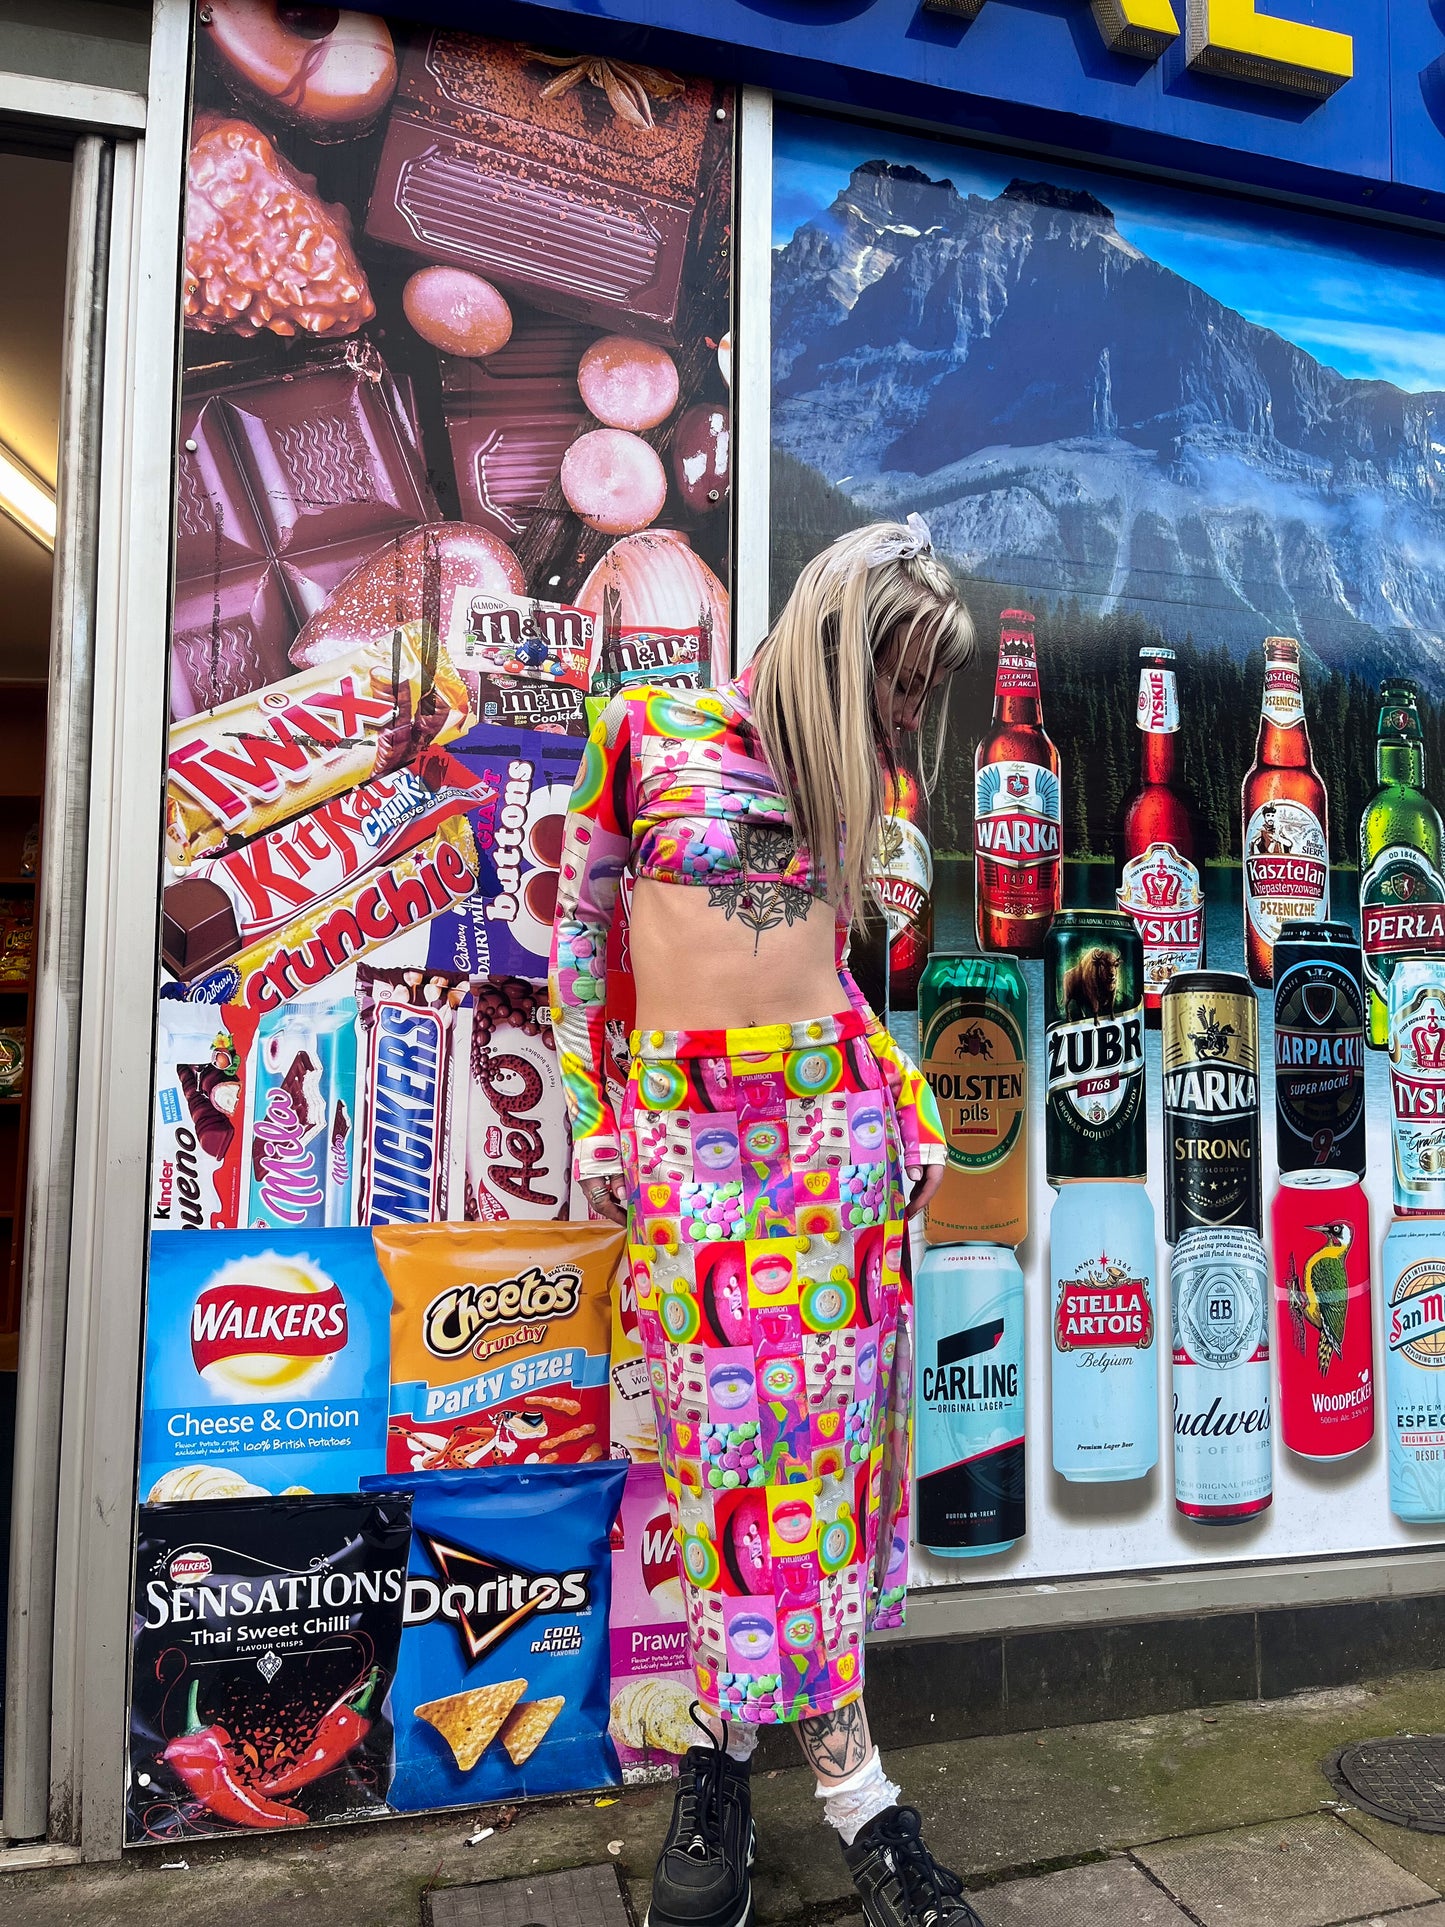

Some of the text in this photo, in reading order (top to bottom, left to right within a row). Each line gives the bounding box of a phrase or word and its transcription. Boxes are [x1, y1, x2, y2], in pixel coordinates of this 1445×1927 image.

[472, 601, 504, 610] ALMOND
[1150, 672, 1164, 729] TYSKIE
[530, 710, 583, 724] Cookies
[392, 806, 424, 827] have
[427, 799, 437, 809] a
[478, 769, 501, 850] GIAT
[485, 759, 534, 923] buttons
[976, 820, 1059, 853] WARKA
[1302, 846, 1324, 858] SIERPC
[1388, 850, 1417, 861] OD 1846
[1002, 874, 1033, 884] 1478
[1248, 860, 1325, 887] Kasztelan
[1253, 882, 1322, 897] Niepasteryzowane
[1260, 901, 1316, 917] PSZENICZNE
[1134, 916, 1199, 944] YSKIE
[1367, 914, 1445, 942] PERŁA
[453, 923, 472, 972] Cadbury
[475, 925, 491, 975] DAIRY
[523, 1048, 557, 1088] feel the bubbles
[742, 1073, 772, 1082] Intuition
[926, 1072, 1023, 1101] HOLSTEN
[1086, 1079, 1110, 1092] 1768
[1164, 1070, 1257, 1112] WARKA
[1290, 1074, 1350, 1096] SUPER MOCNE
[370, 1006, 438, 1225] NICKERS
[960, 1103, 990, 1126] pils
[1058, 1100, 1081, 1133] BROWAR
[1083, 1128, 1115, 1142] DOJLIDY
[1175, 1137, 1251, 1161] STRONG
[806, 1176, 829, 1190] 666
[648, 1187, 670, 1201] 666
[946, 1217, 1020, 1231] BREWING EXCELLENCE
[1196, 1242, 1243, 1250] Aging produces
[1199, 1250, 1211, 1259] will
[1211, 1250, 1225, 1258] find
[1242, 1252, 1255, 1260] other
[1074, 1258, 1132, 1275] ANNO 1366
[1396, 1274, 1412, 1299] CERVEZA
[427, 1268, 575, 1351] Cheetos
[758, 1306, 788, 1314] Intuition
[1066, 1294, 1142, 1314] STELLA
[1209, 1299, 1233, 1320] AB
[193, 1300, 347, 1342] WALKERS
[1066, 1315, 1143, 1335] ARTOIS
[1389, 1308, 1422, 1343] San
[474, 1325, 548, 1360] Crunchy
[1076, 1351, 1134, 1373] Belgium
[1405, 1345, 1431, 1364] EXPLORING
[426, 1353, 573, 1416] Party Size!
[923, 1363, 1018, 1401] CARLING
[1311, 1381, 1372, 1413] WOODPECKER
[937, 1401, 1003, 1414] ORIGINAL LAGER
[167, 1406, 359, 1437] Cheese & Onion
[819, 1416, 839, 1430] 666
[243, 1436, 351, 1451] 100% British Potatoes
[1077, 1443, 1102, 1451] Premium
[1103, 1442, 1121, 1451] Lager
[1401, 1435, 1432, 1443] ORIGINAL
[1208, 1446, 1229, 1455] OF
[1415, 1449, 1440, 1461] DESDE
[1198, 1492, 1219, 1500] RICE
[171, 1560, 210, 1574] WALKERS
[780, 1554, 810, 1564] Intuition
[145, 1569, 401, 1629] SENSATIONS
[403, 1573, 586, 1623] Doritos
[191, 1615, 350, 1646] Thai Sweet Chilli
[544, 1626, 581, 1639] COOL
[236, 1640, 304, 1652] FLAVOUR CRISPS
[530, 1638, 582, 1653] RANCH
[550, 1649, 580, 1657] FLAVORED
